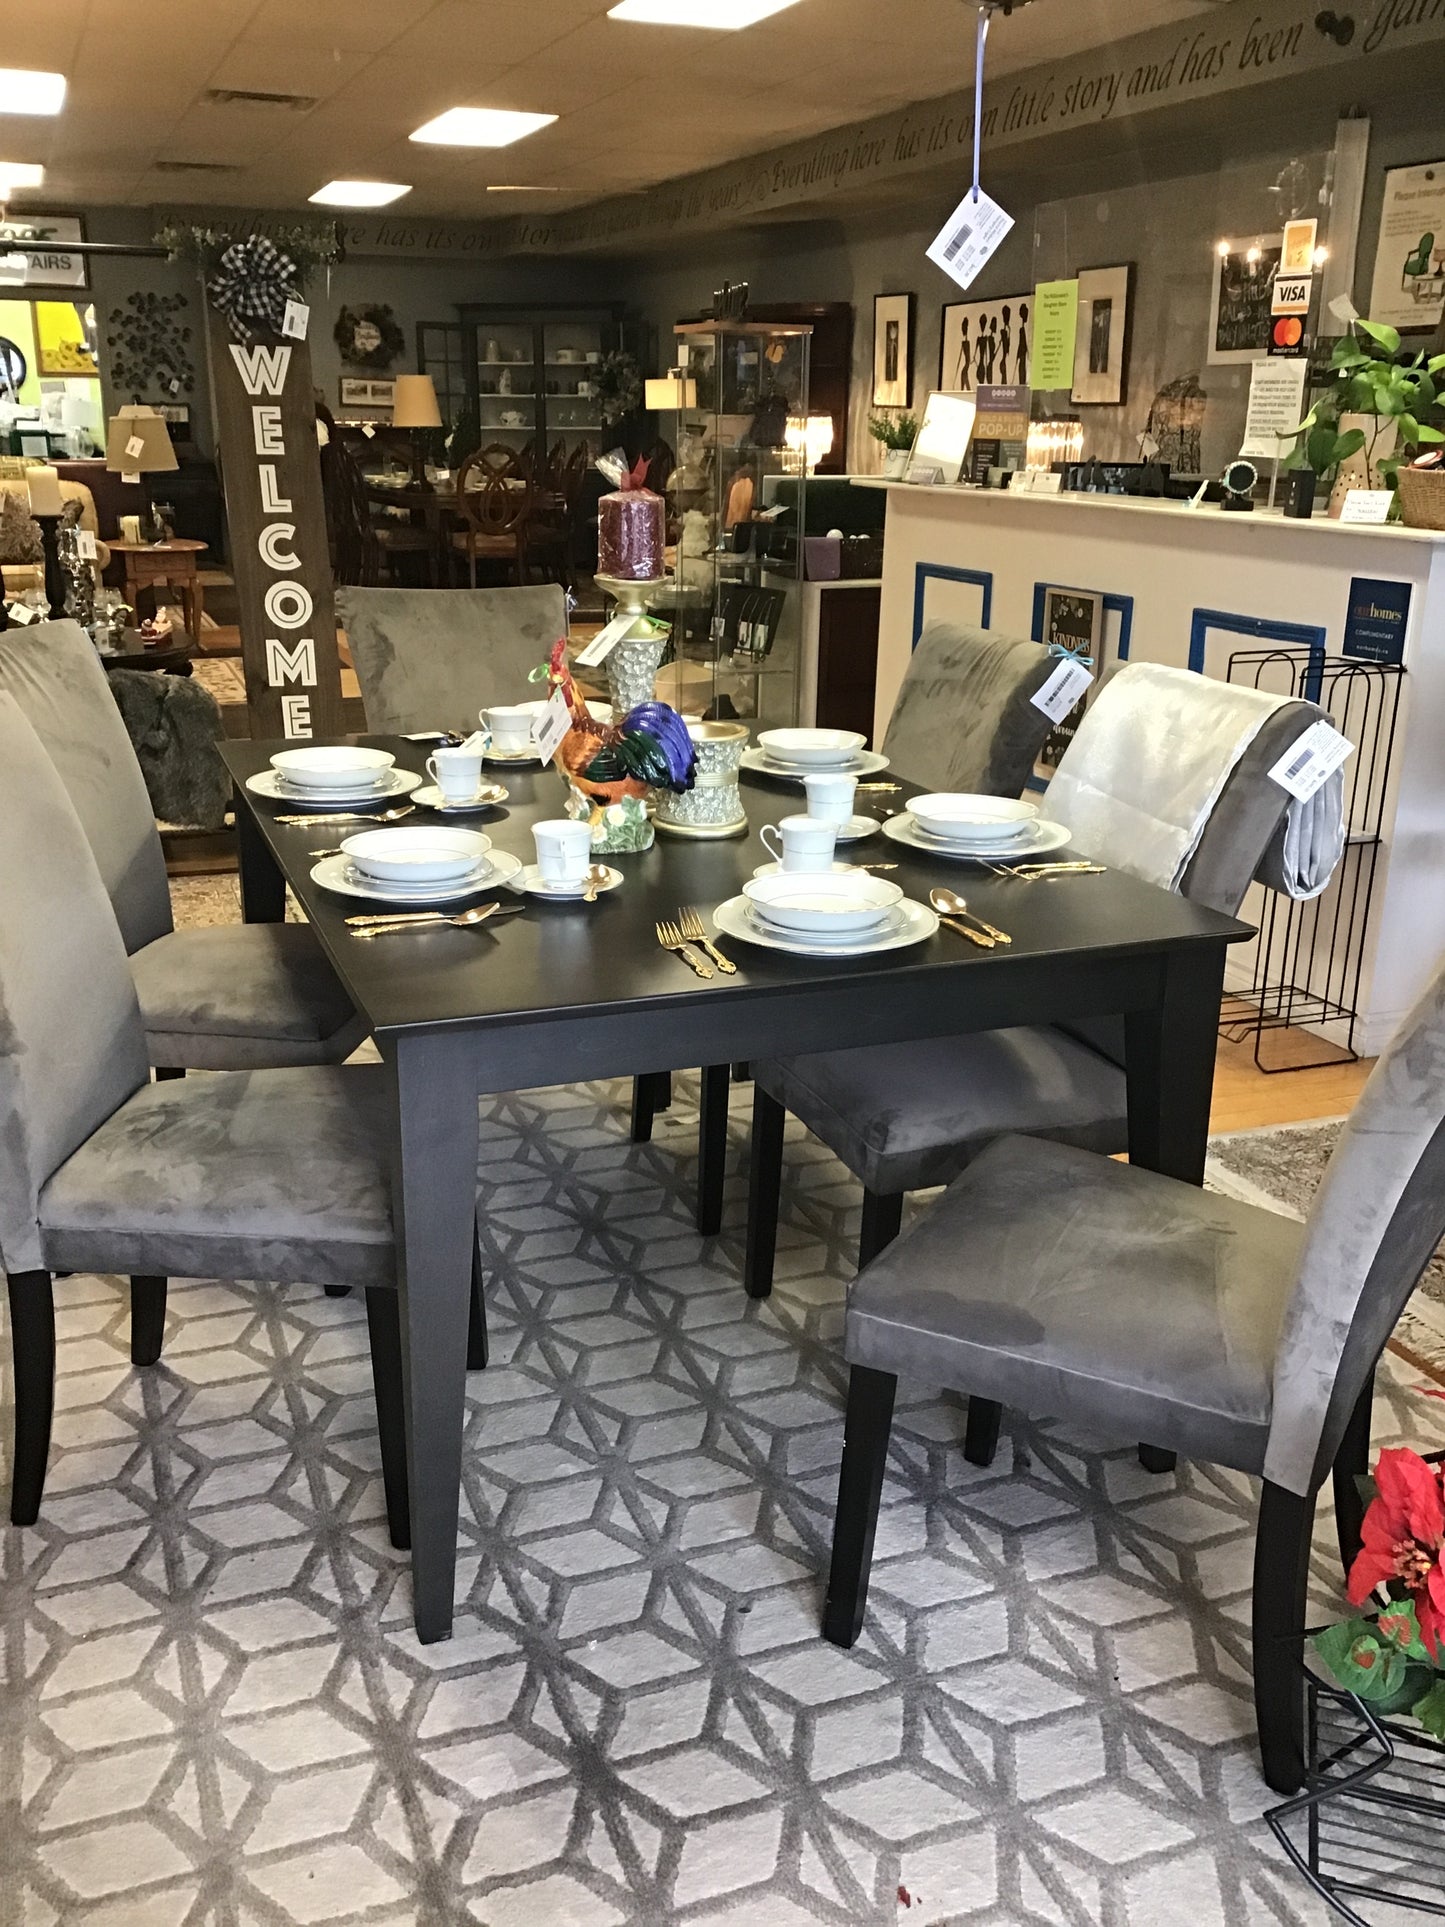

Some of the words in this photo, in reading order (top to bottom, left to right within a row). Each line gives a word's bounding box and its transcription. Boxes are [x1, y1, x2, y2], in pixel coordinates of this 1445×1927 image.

[849, 129, 886, 172] here
[893, 117, 926, 161] has
[926, 115, 954, 153] its
[1002, 86, 1055, 132] little
[1060, 70, 1124, 119] story
[1126, 37, 1188, 97] and
[1178, 31, 1232, 86] has
[1237, 16, 1305, 71] been
[1279, 285, 1306, 302] VISA
[228, 343, 318, 740] WELCOME
